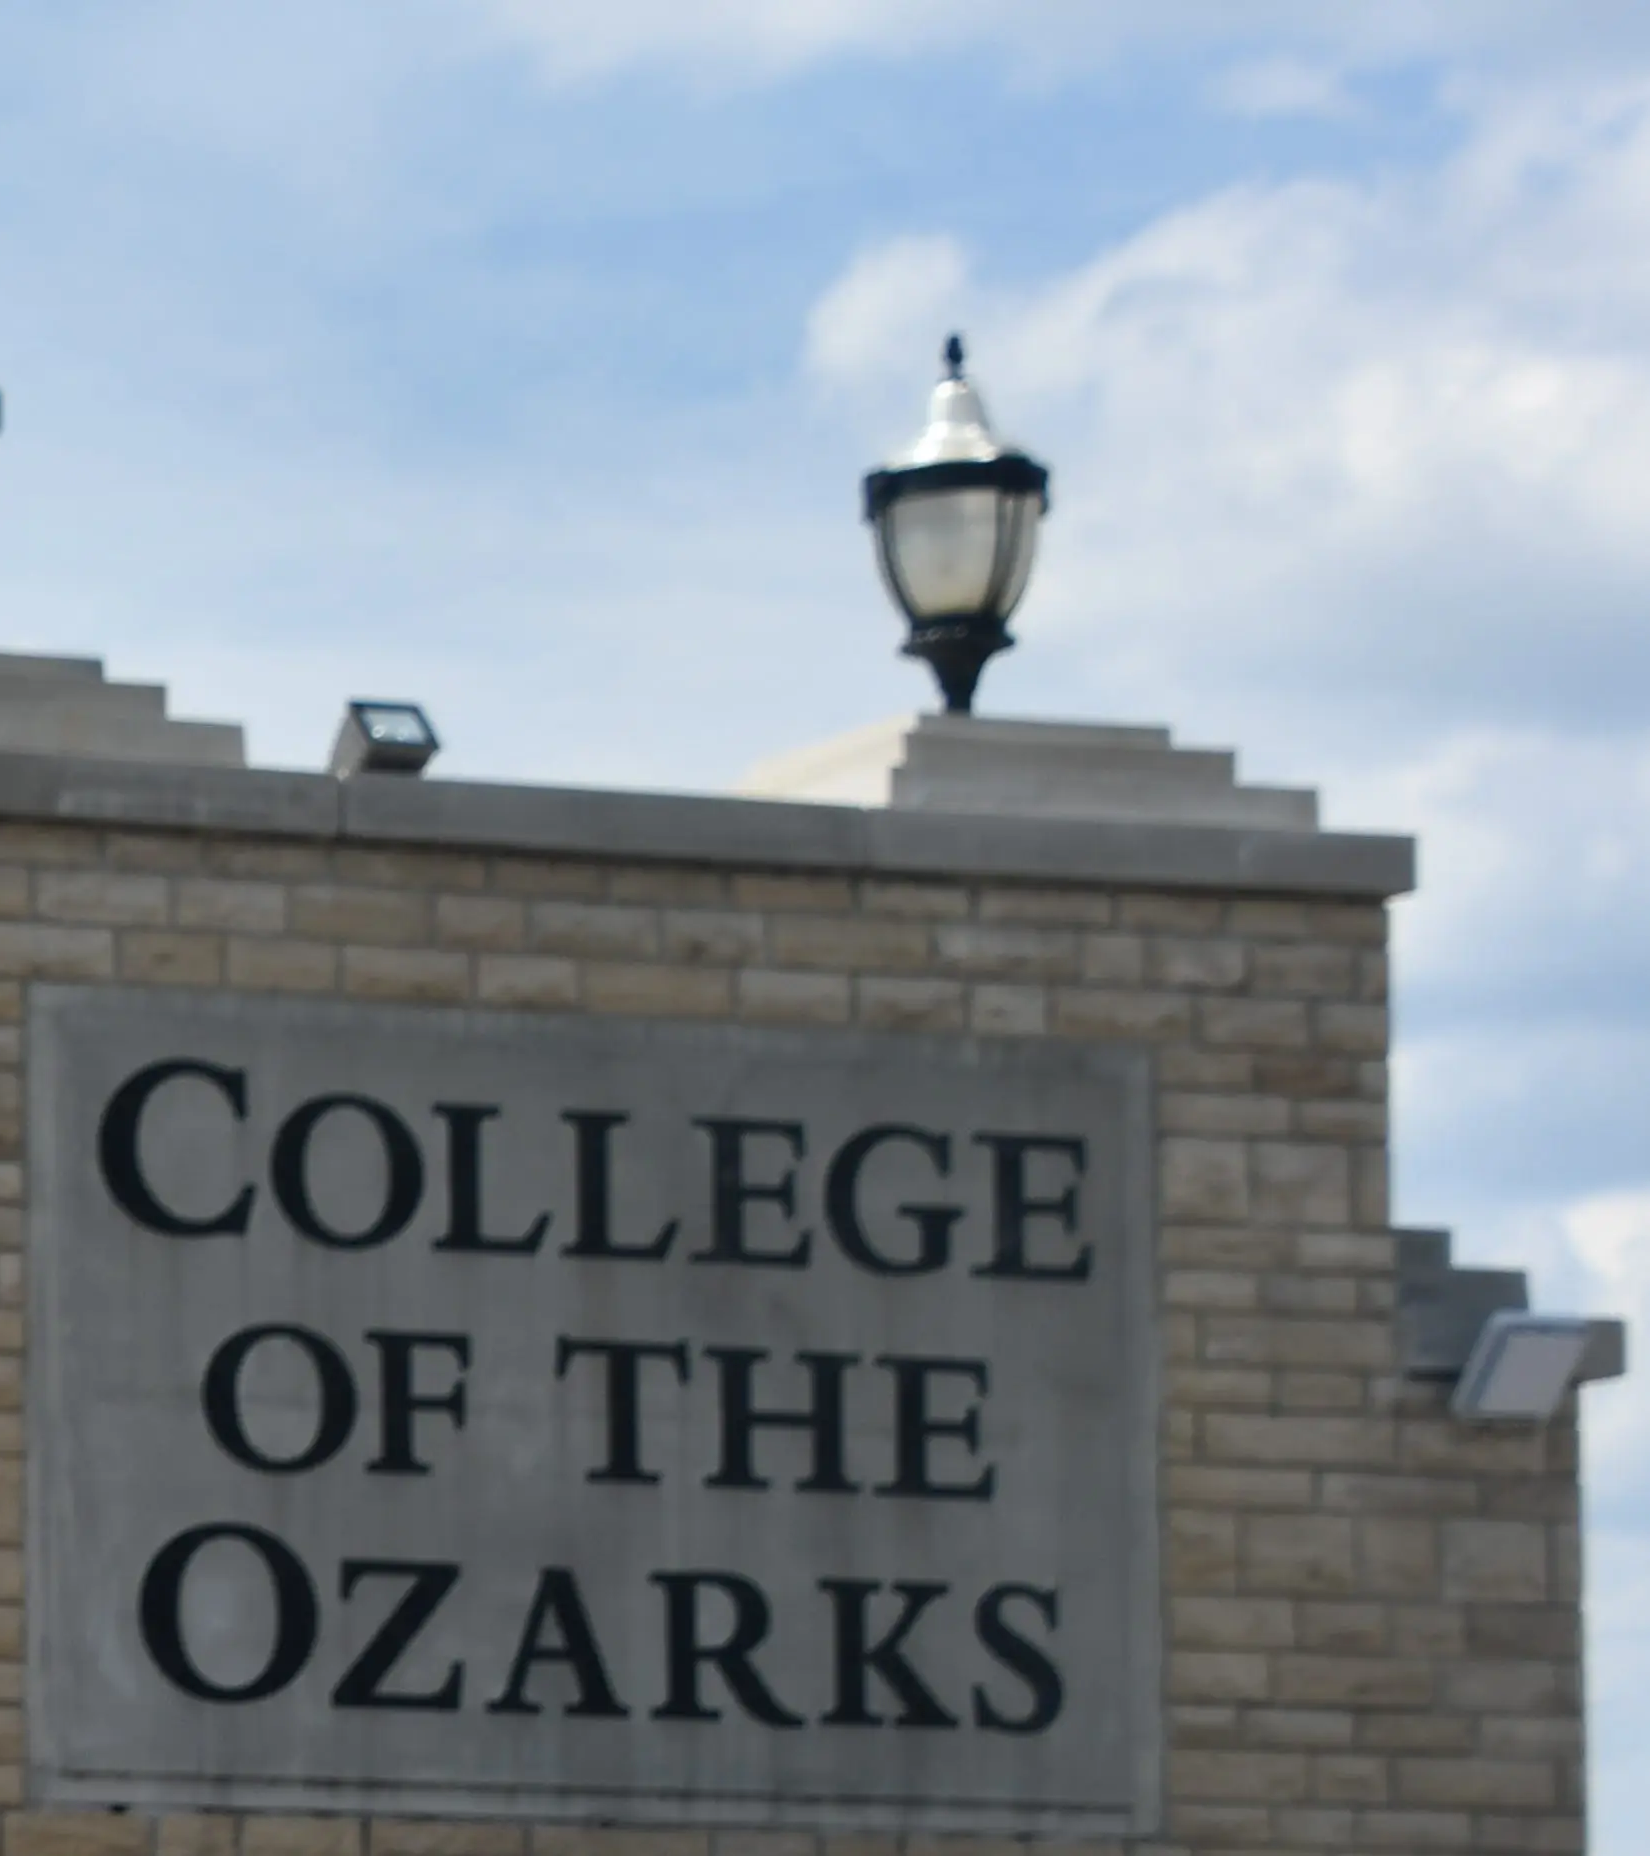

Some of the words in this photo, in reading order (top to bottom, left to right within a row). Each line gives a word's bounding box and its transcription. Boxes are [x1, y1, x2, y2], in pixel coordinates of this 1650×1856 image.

[95, 1056, 1097, 1287] COLLEGE
[199, 1322, 474, 1479] OF
[553, 1334, 997, 1508] THE
[136, 1521, 1068, 1738] OZARKS
